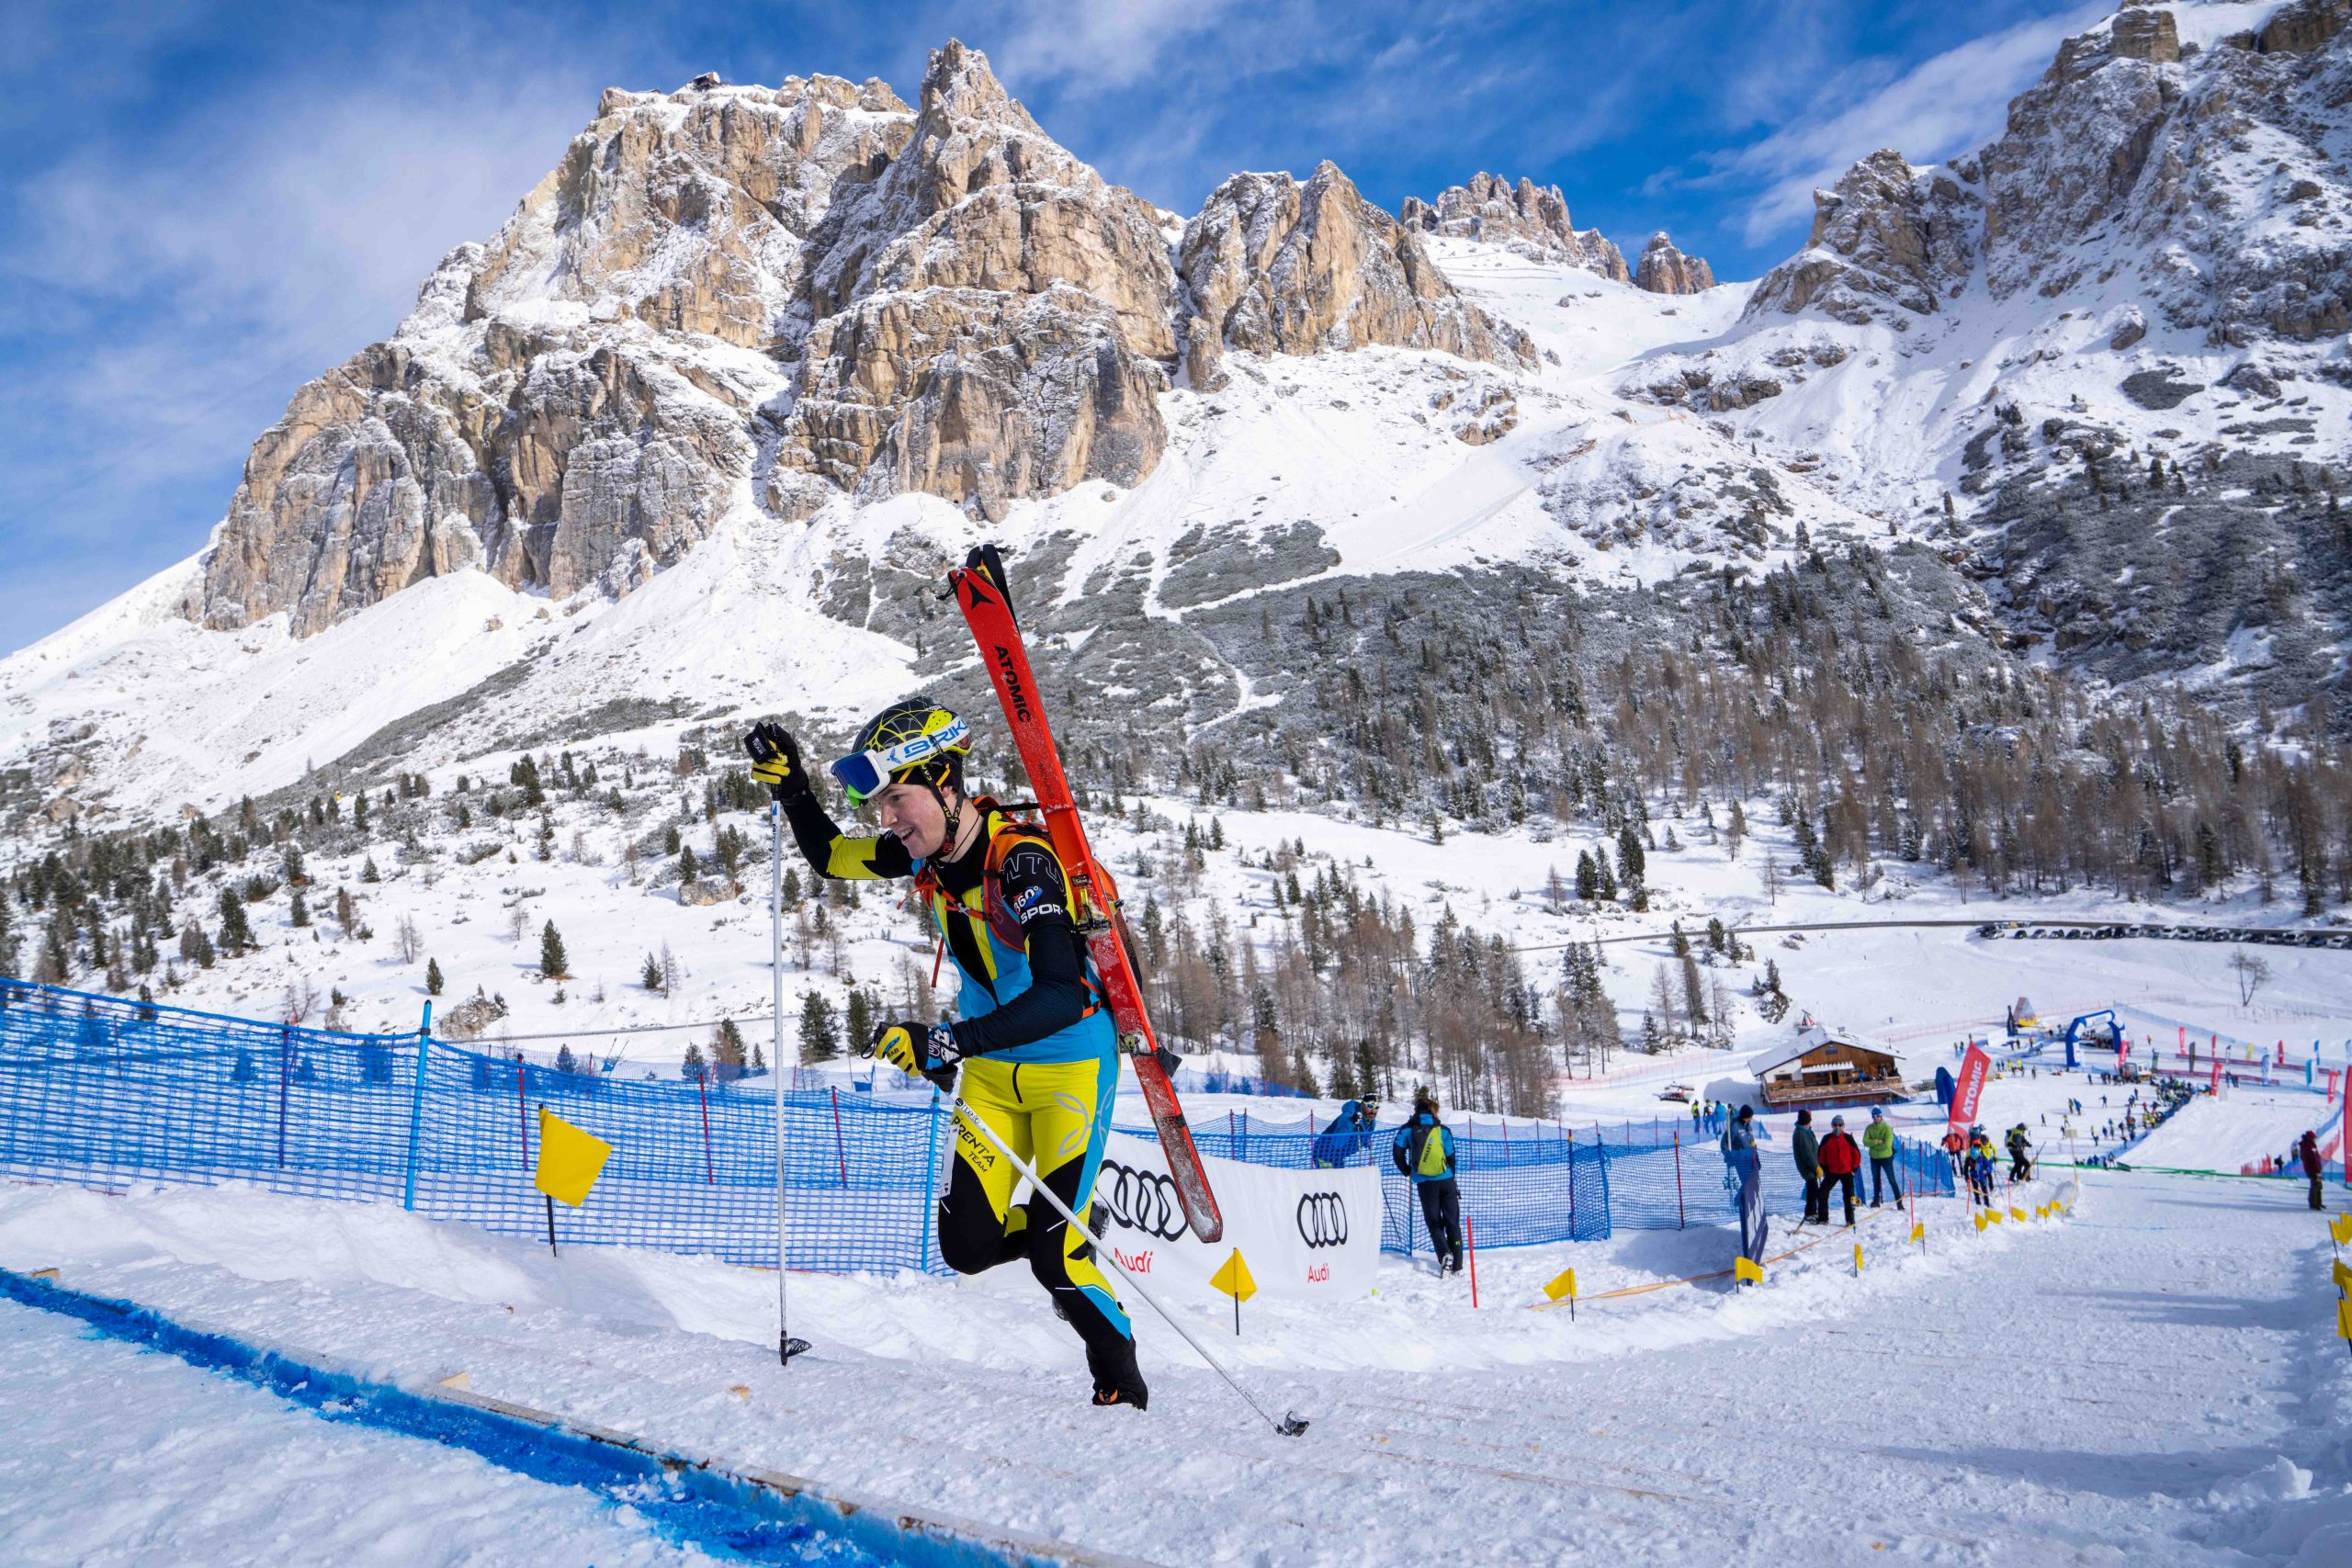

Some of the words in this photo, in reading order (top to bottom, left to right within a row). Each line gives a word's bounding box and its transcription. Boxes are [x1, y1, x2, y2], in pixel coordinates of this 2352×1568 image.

[995, 646, 1031, 723] ATOMIC
[1021, 903, 1063, 925] SPOR
[1962, 1060, 1982, 1118] ATOMIC
[968, 1151, 988, 1173] TEAM
[1307, 1262, 1329, 1283] Audi
